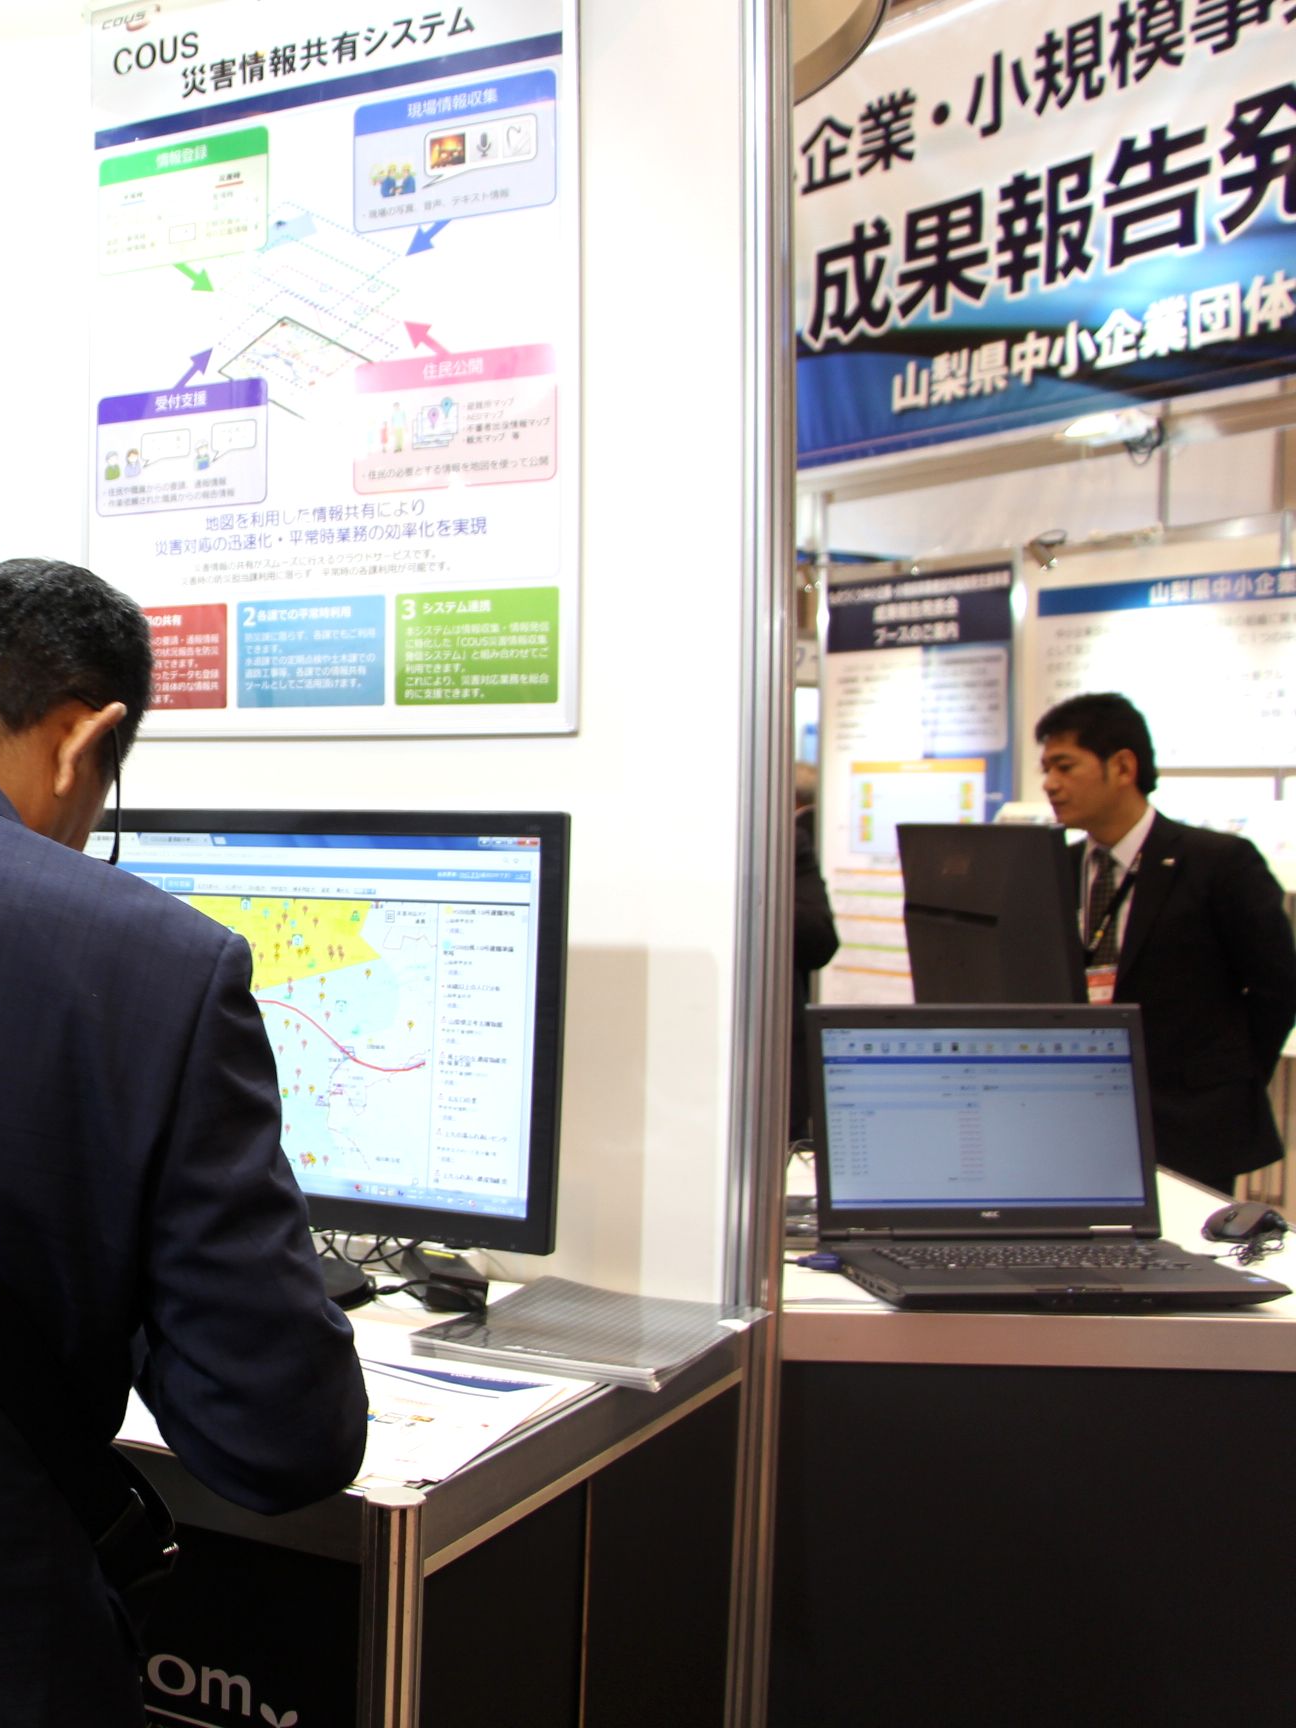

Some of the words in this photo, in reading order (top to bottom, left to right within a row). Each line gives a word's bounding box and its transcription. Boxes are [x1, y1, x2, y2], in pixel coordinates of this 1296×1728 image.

[112, 31, 200, 75] COUS
[181, 6, 475, 98] 災害情報共有システム
[407, 87, 498, 119] 現場情報収集
[422, 357, 484, 381] 住民公開
[155, 390, 208, 412] 受付支援
[205, 498, 425, 532] 地図を利用した情報共有により
[154, 516, 487, 557] 災害対応の迅速化・平常時業務の効率化を実現
[242, 606, 257, 628] 2
[401, 599, 416, 621] 3
